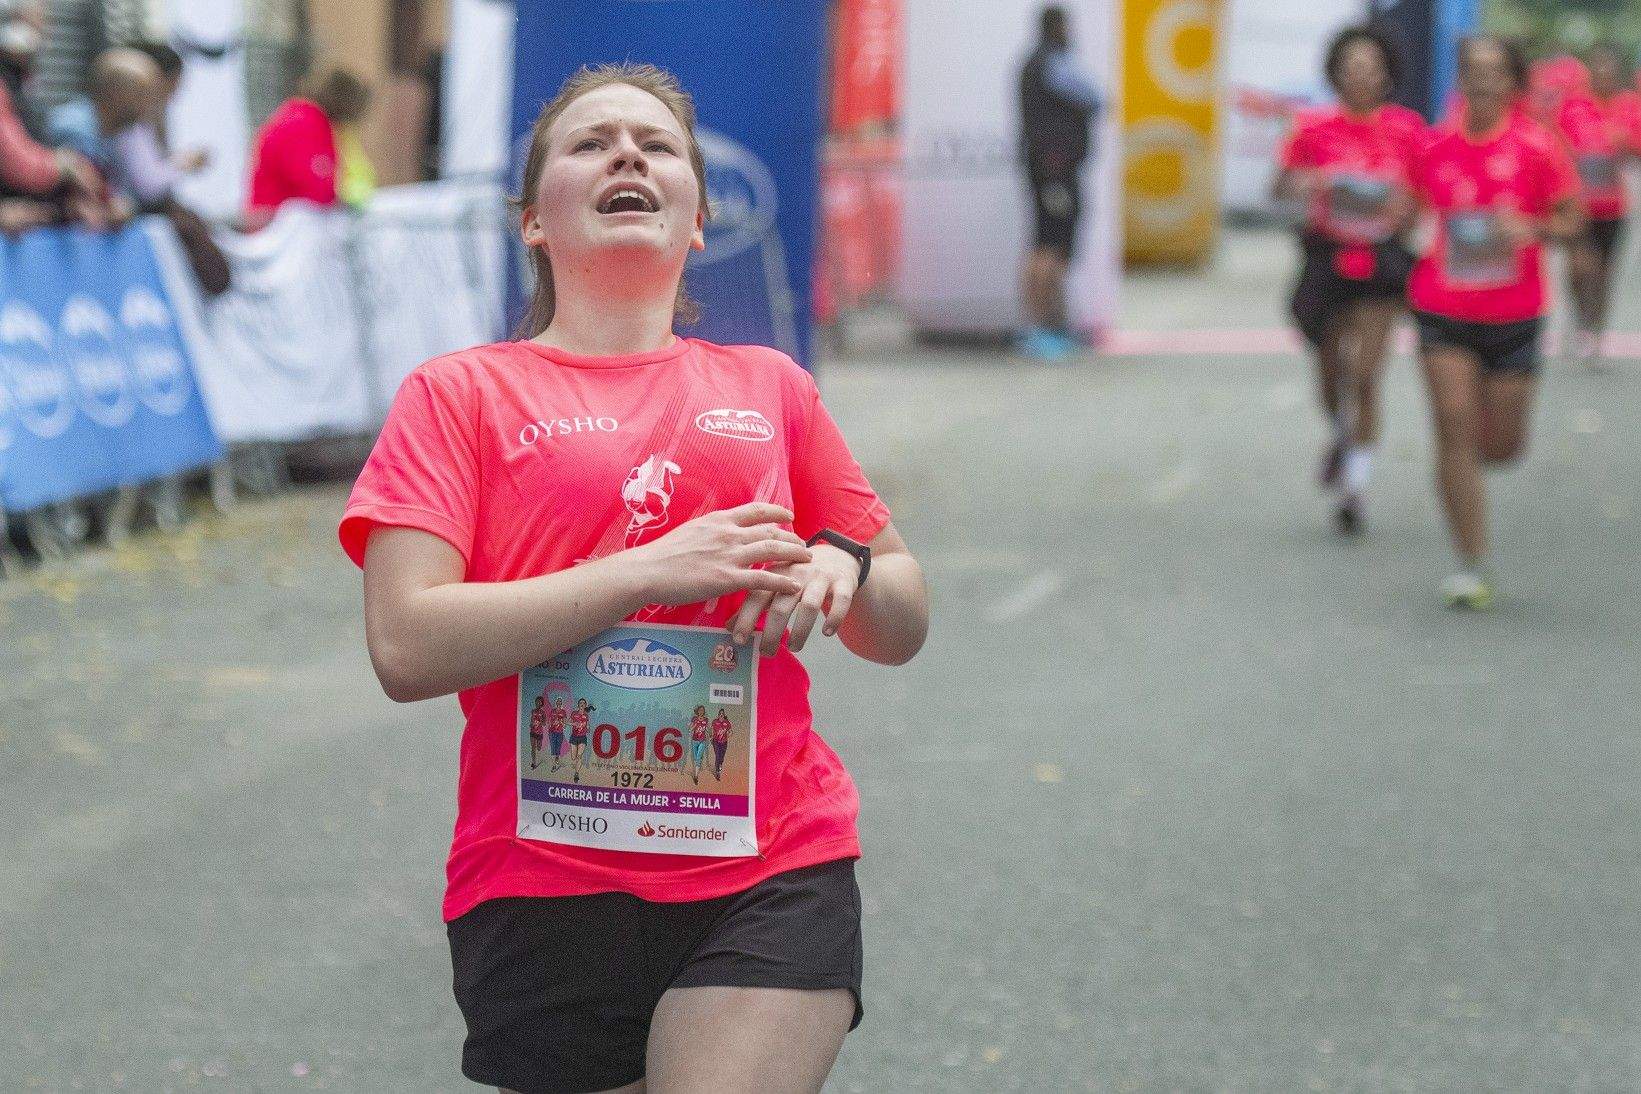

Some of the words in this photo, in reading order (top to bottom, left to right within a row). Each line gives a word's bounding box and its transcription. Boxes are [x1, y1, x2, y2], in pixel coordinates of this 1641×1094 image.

[519, 416, 619, 446] OYSHO
[592, 653, 685, 679] ASTURIANA
[592, 723, 684, 763] 016
[611, 771, 654, 789] 1972
[548, 786, 593, 802] CARRERA
[596, 791, 610, 803] DE
[613, 793, 627, 805] LA
[630, 794, 669, 807] MUJER
[679, 796, 720, 810] SEVILLA
[542, 811, 608, 834] OYSHO
[657, 825, 728, 841] Santander
